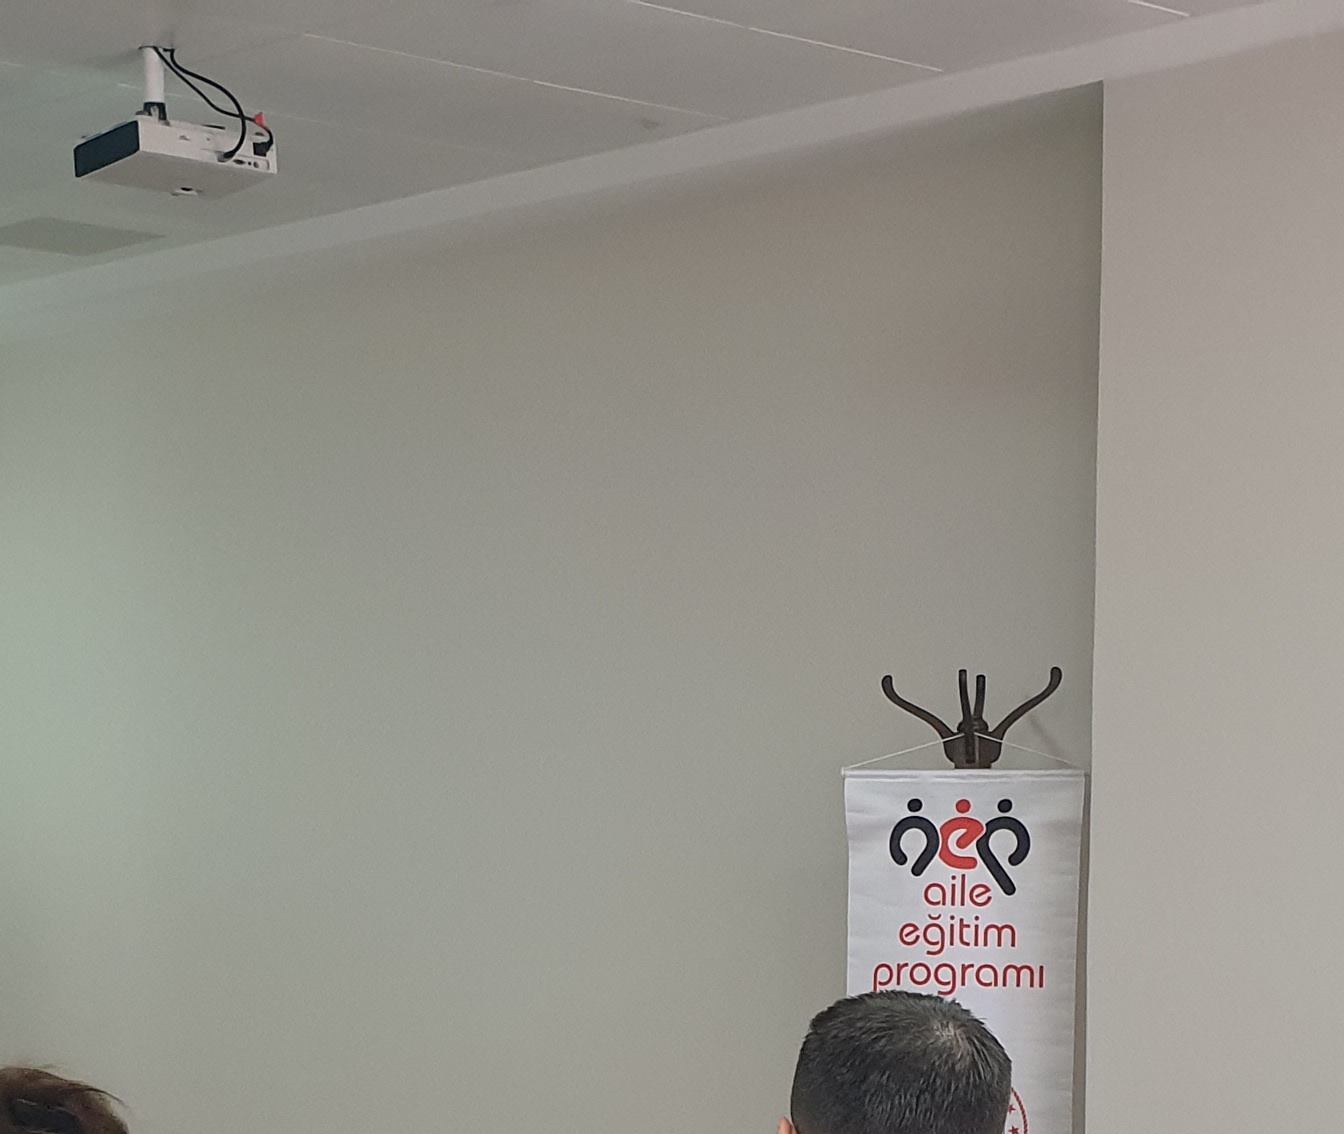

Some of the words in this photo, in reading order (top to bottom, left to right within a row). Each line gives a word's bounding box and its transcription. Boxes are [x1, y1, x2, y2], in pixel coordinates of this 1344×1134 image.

[923, 873, 992, 907] aile
[899, 913, 1017, 955] eğitim
[873, 962, 1044, 996] programı
